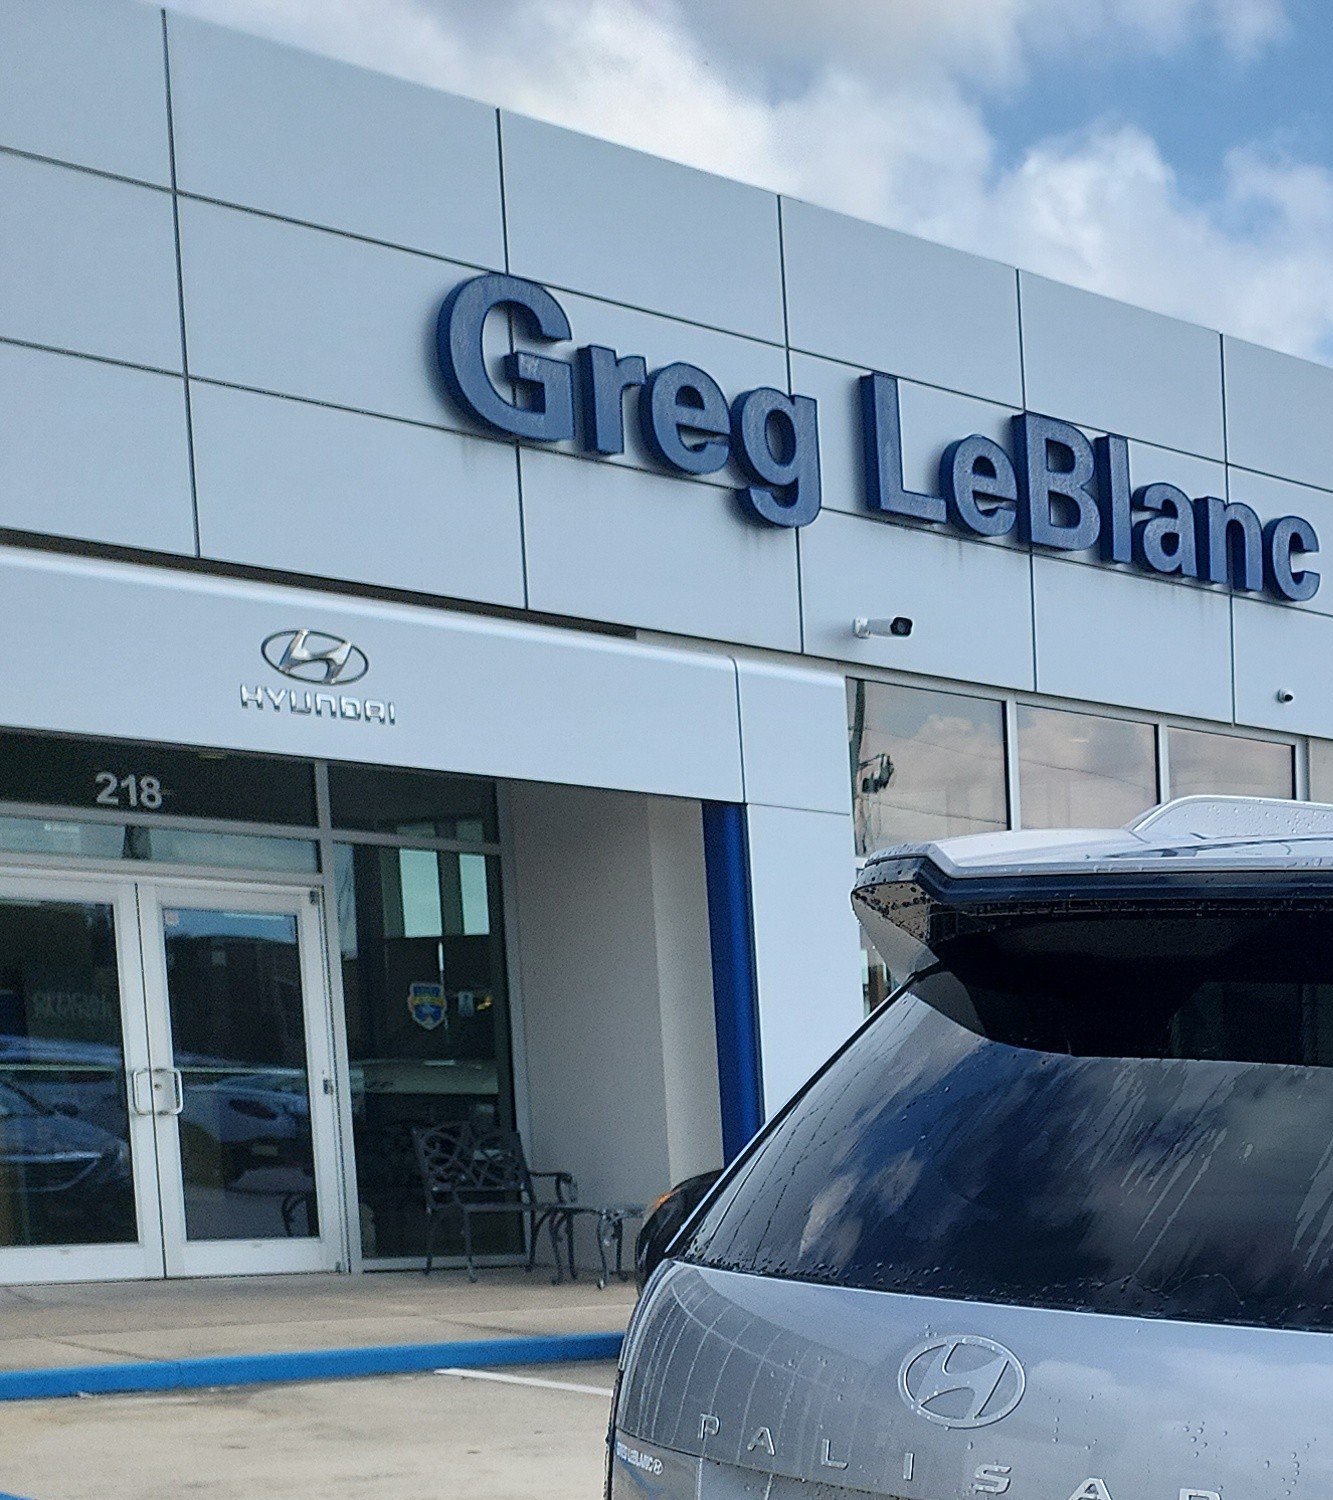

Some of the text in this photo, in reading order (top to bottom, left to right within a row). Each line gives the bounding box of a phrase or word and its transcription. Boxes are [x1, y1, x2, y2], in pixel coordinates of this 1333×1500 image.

[436, 271, 1321, 602] Greg LeBlanc
[239, 683, 397, 726] HYUNDAI
[95, 771, 163, 810] 218
